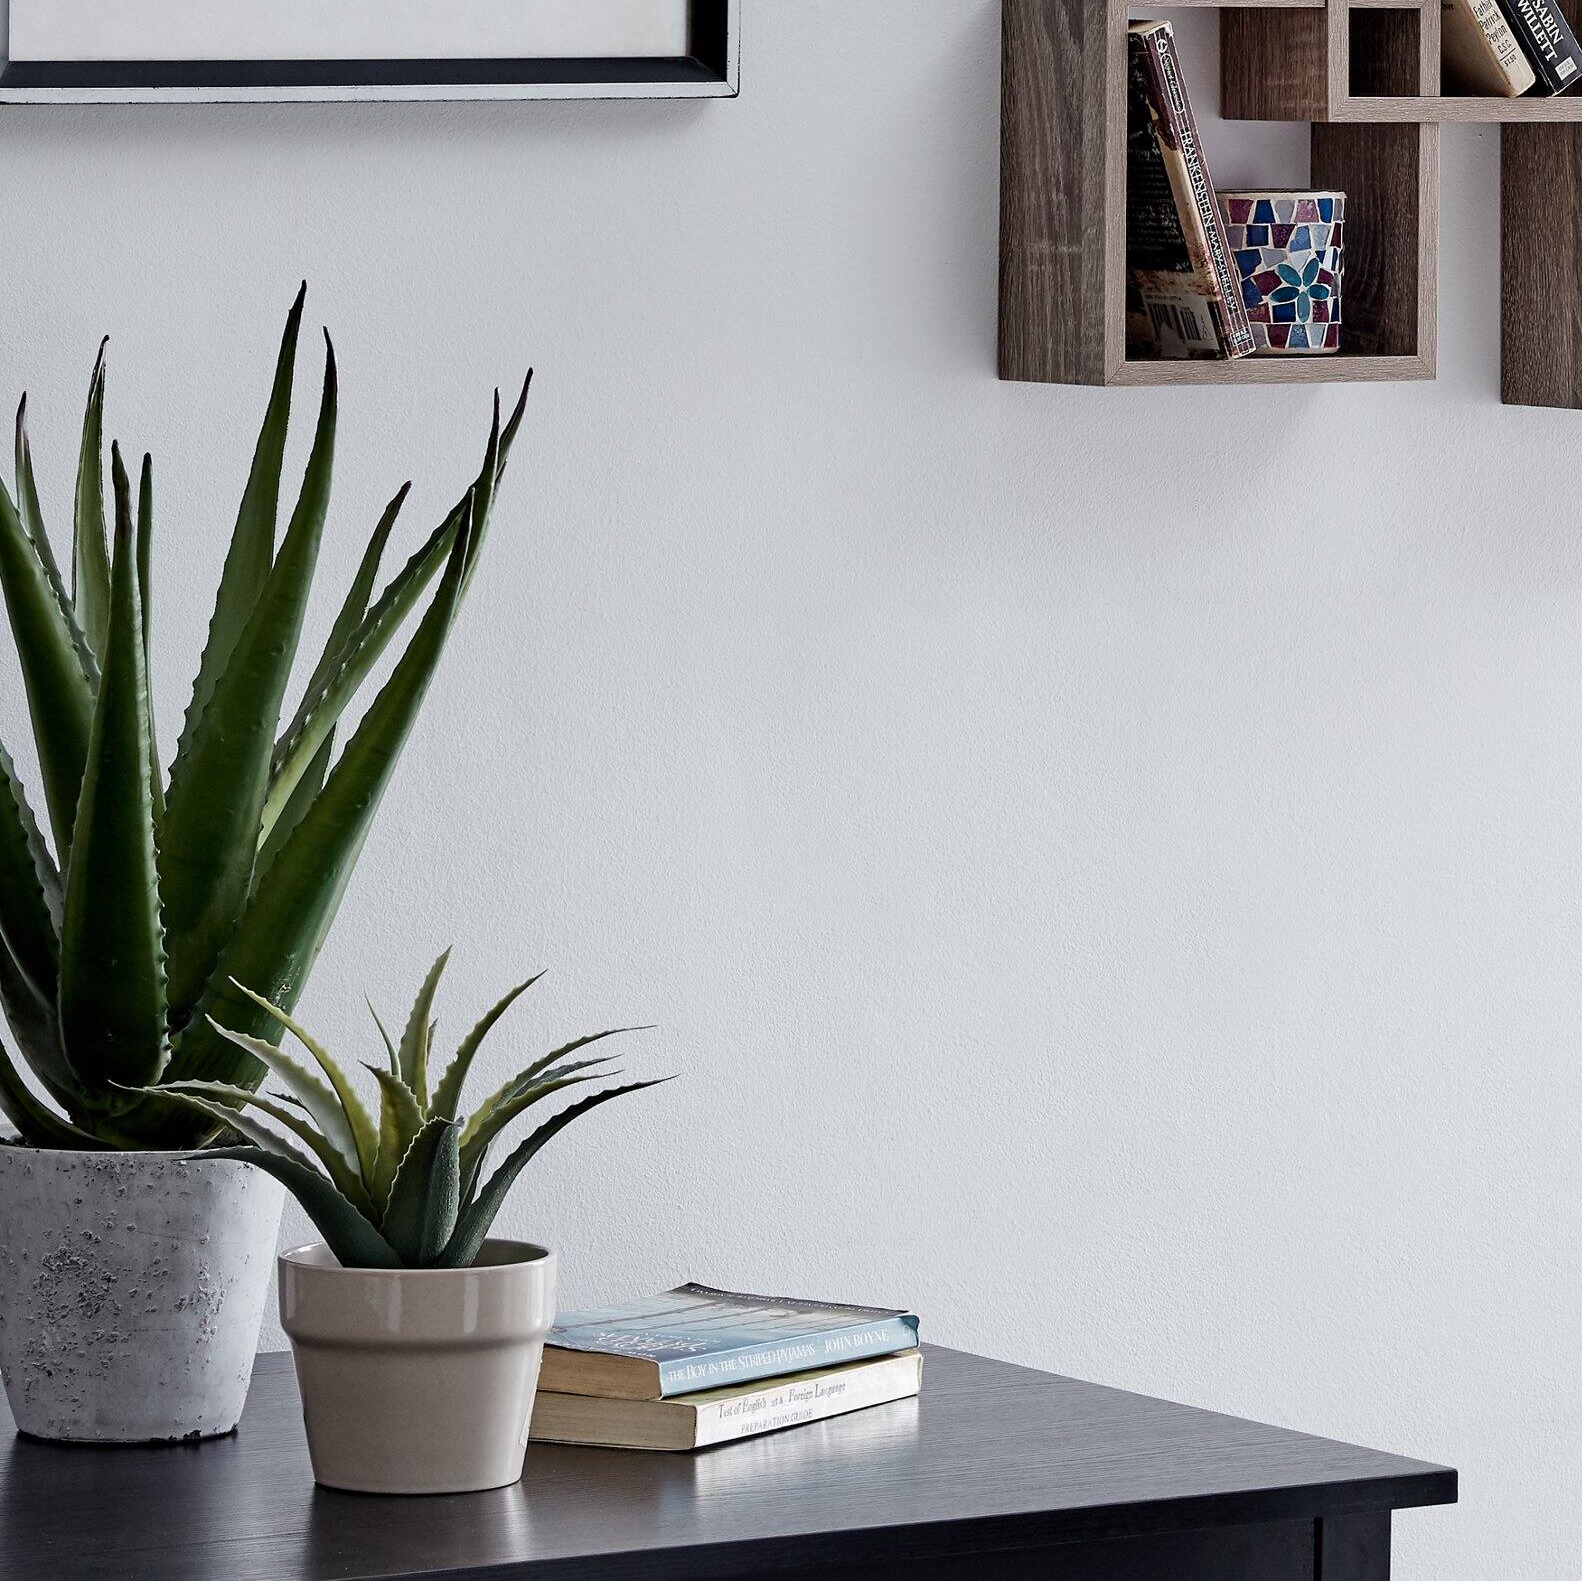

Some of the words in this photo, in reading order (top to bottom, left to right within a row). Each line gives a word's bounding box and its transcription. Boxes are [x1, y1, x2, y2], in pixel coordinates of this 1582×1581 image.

[1478, 9, 1502, 32] Patrick
[1485, 24, 1508, 45] Peyton
[1180, 129, 1216, 228] FRANKENSTEIN
[1217, 262, 1238, 310] SHELLEY
[668, 1368, 686, 1382] THE
[706, 1363, 720, 1375] IN
[720, 1360, 738, 1374] THE
[777, 1343, 816, 1365] PYJAMAS
[824, 1336, 852, 1354] JOHN
[853, 1328, 890, 1348] BOYNE
[718, 1404, 733, 1419] Test
[734, 1402, 742, 1416] of
[742, 1397, 767, 1414] English
[788, 1388, 813, 1405] Foreign
[814, 1381, 846, 1399] Language
[741, 1413, 791, 1435] PREPARATION
[791, 1408, 813, 1423] GUIDE
